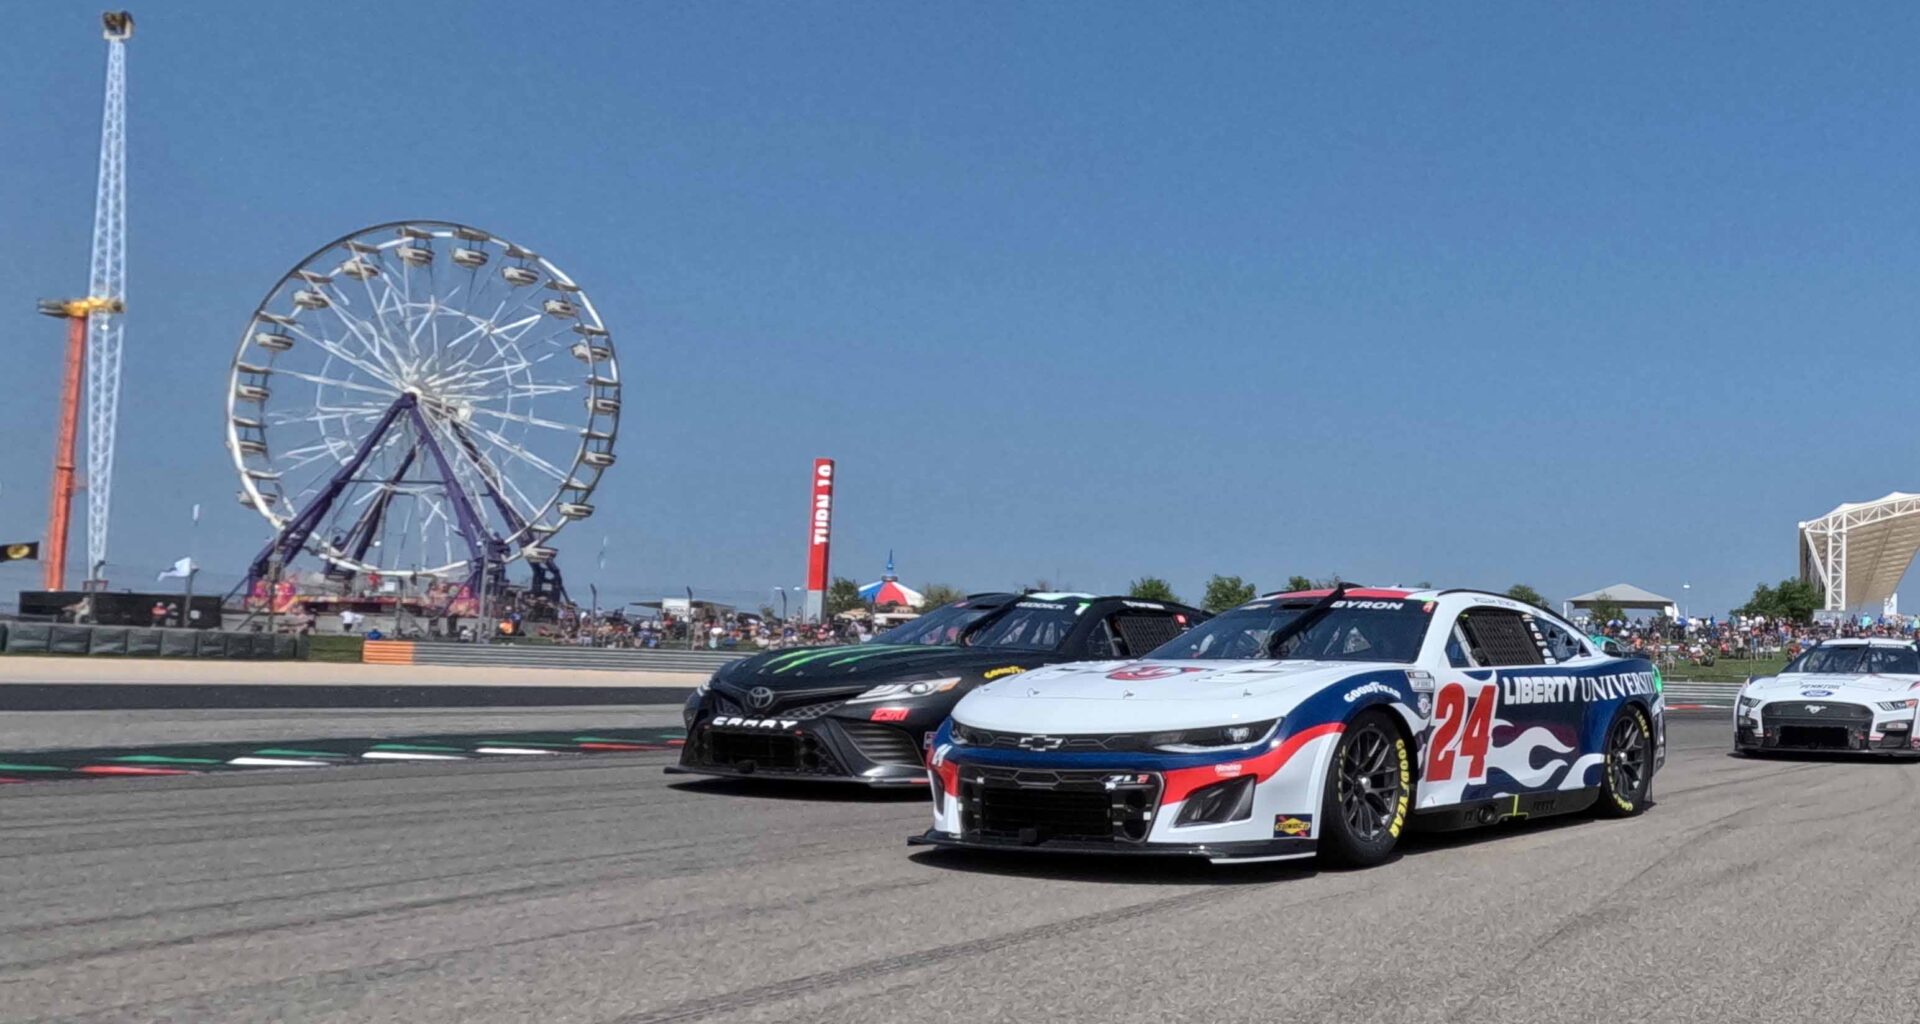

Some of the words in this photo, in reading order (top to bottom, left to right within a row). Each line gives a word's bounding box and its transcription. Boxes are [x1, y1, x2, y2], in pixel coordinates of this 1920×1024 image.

[1330, 600, 1403, 610] BYRON
[1343, 681, 1402, 702] GOODYEAR
[1502, 676, 1577, 705] LIBERTY
[712, 716, 798, 729] CAMRY
[1424, 682, 1497, 783] 24
[1388, 738, 1410, 839] GOODYEAR
